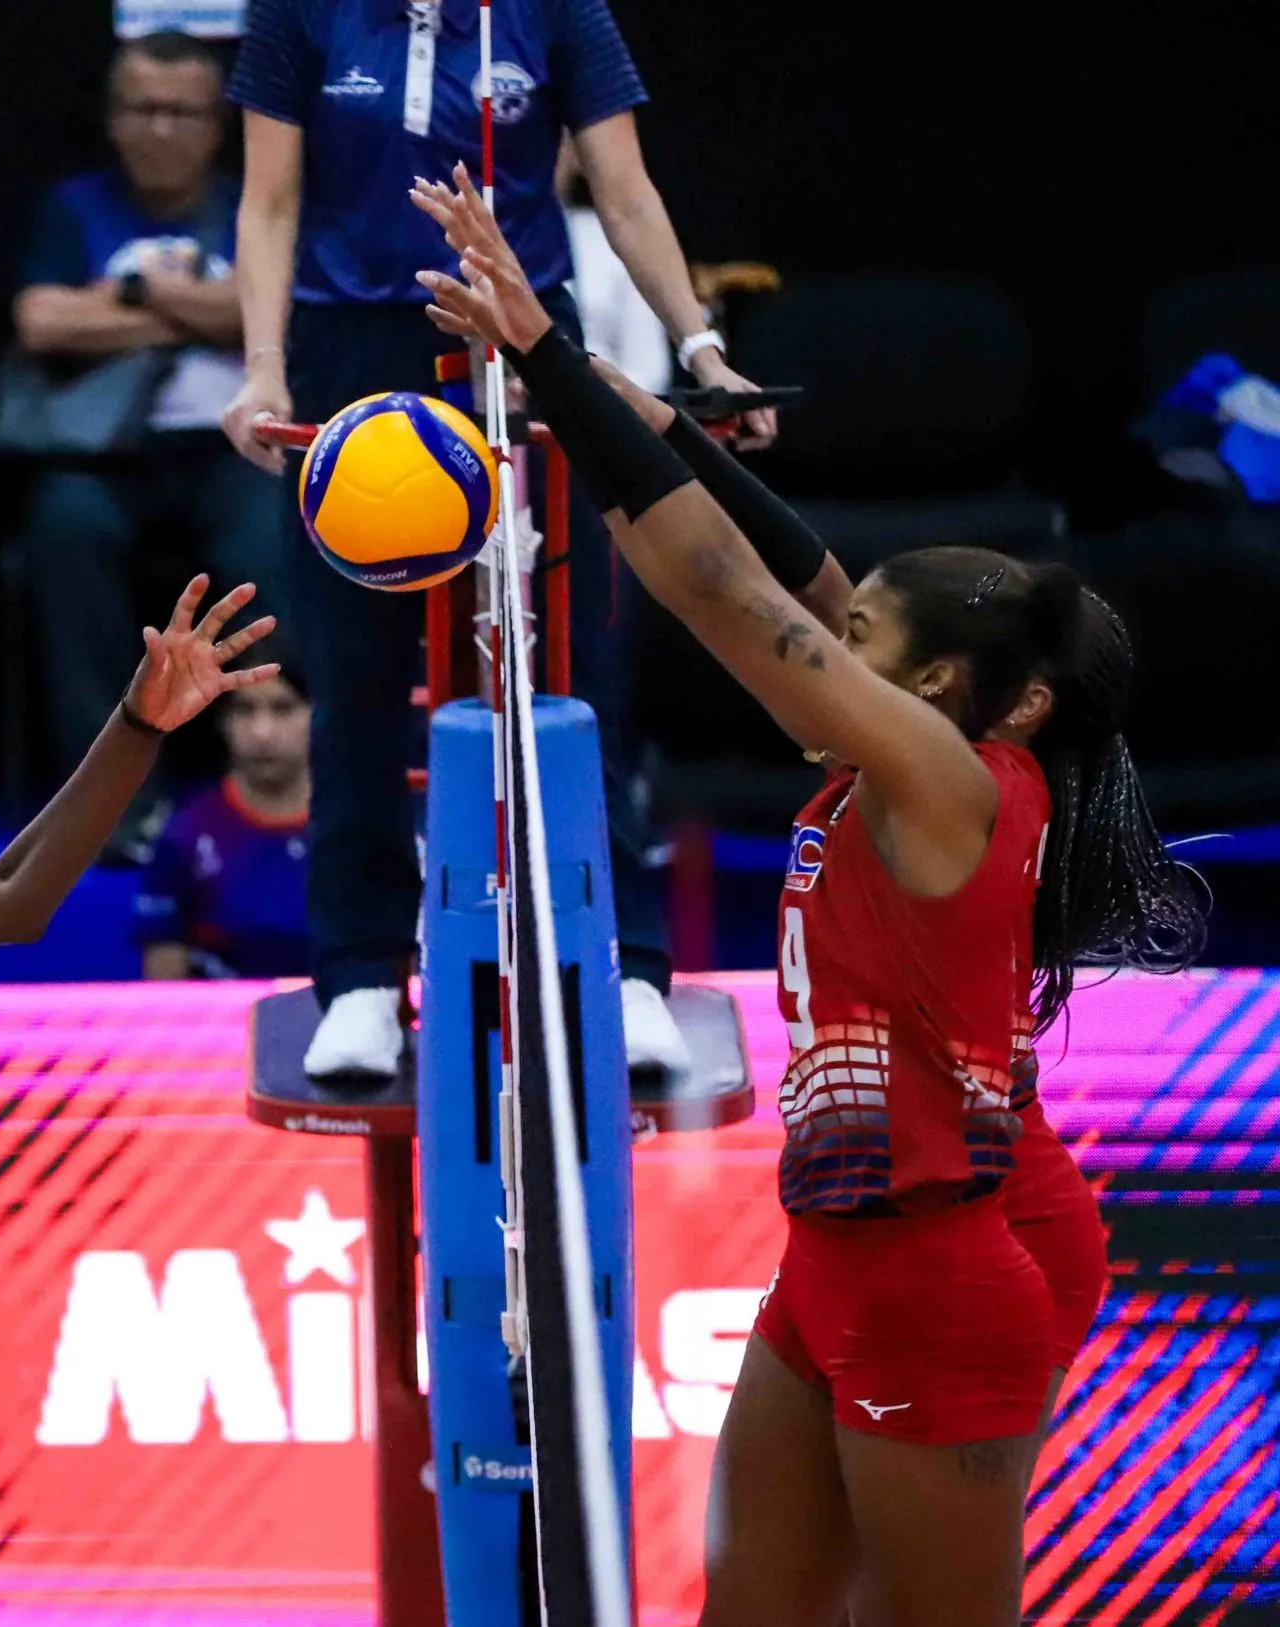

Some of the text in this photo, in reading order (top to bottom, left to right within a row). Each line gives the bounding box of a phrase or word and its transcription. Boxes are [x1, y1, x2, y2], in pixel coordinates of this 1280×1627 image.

[453, 442, 480, 475] FIVB
[360, 568, 408, 582] V200W
[781, 906, 815, 1049] 9
